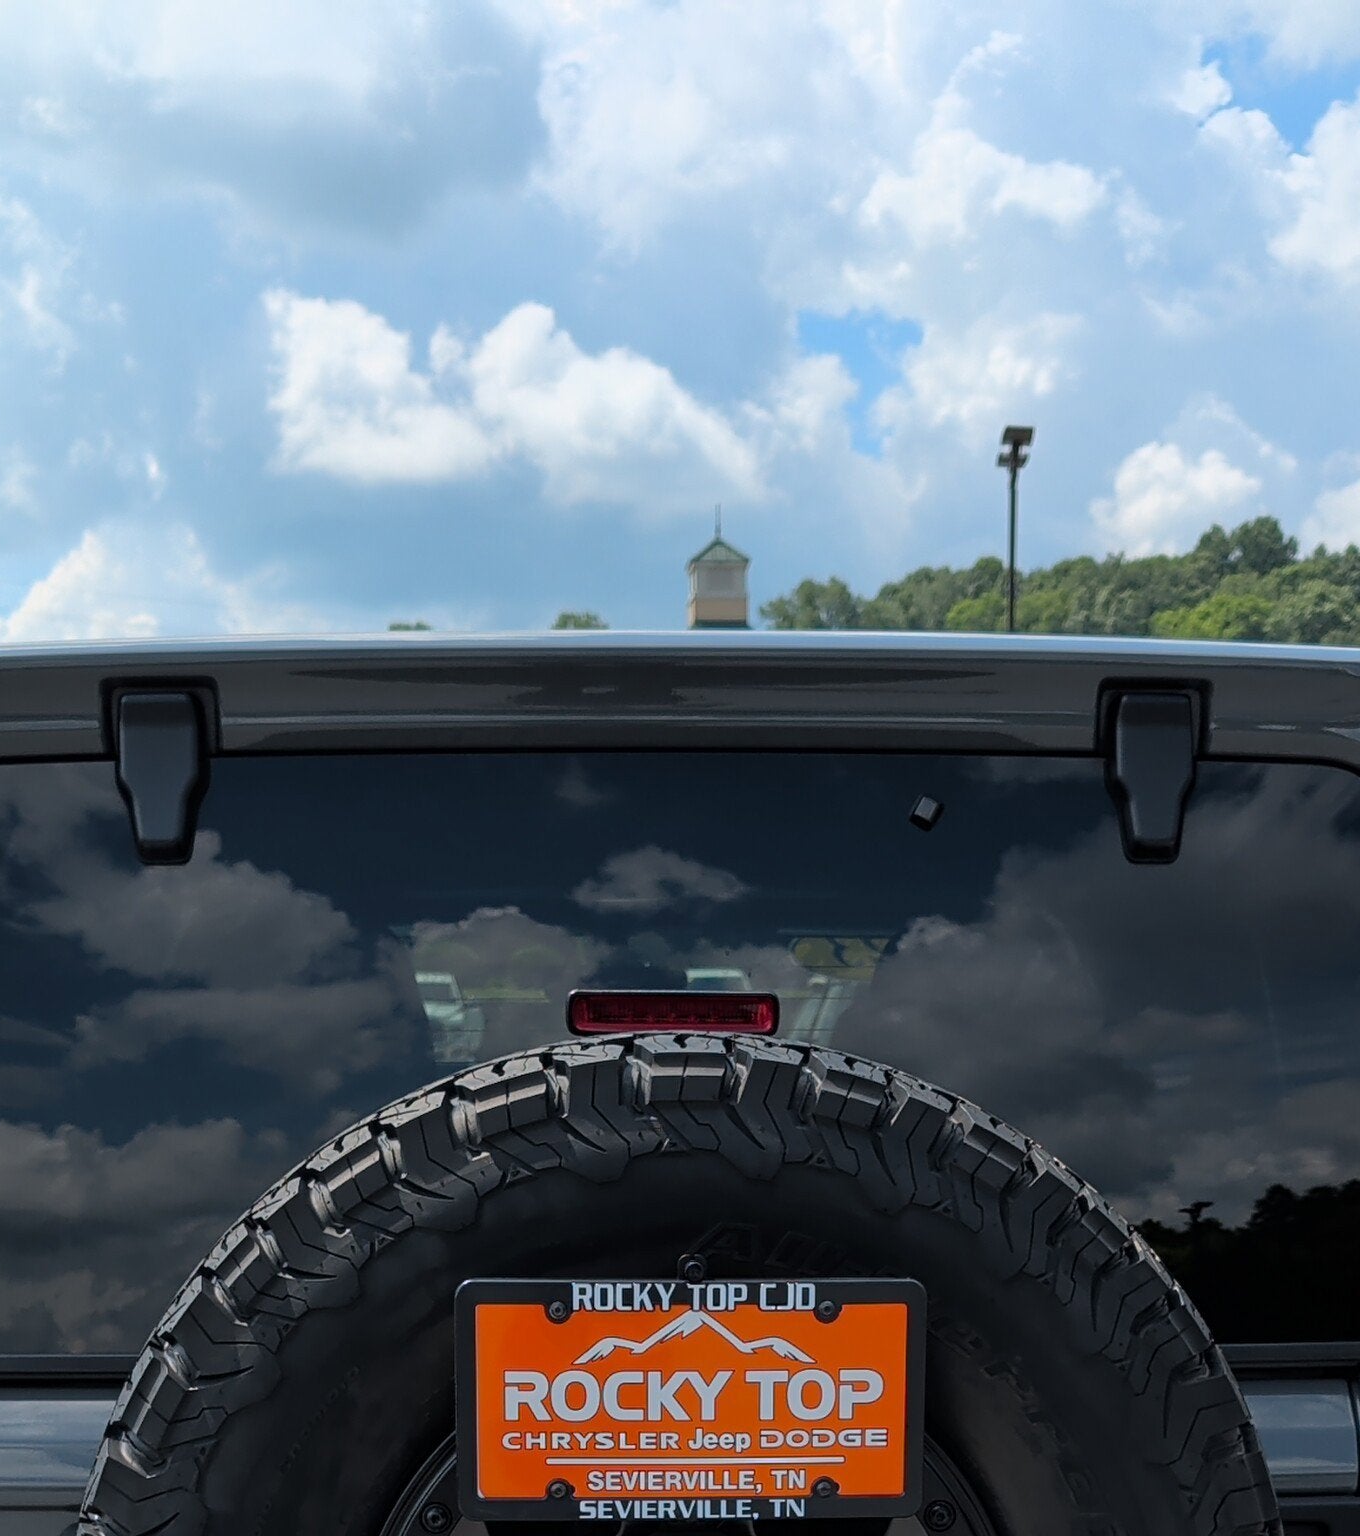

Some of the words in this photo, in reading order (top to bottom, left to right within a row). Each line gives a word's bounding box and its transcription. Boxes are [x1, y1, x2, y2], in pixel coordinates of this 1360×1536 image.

[572, 1283, 675, 1310] ROCKY
[687, 1283, 748, 1310] TOP
[760, 1283, 817, 1310] CJD
[503, 1370, 735, 1422] ROCKY
[745, 1369, 885, 1422] TOP
[502, 1432, 680, 1450] CHRYSLER
[687, 1428, 752, 1452] Jeep
[760, 1429, 889, 1448] DODGE
[587, 1470, 764, 1494] SEVIERVILLE,
[771, 1470, 807, 1490] TN
[579, 1500, 760, 1520] SEVIERVILLE,
[769, 1499, 806, 1518] TN
